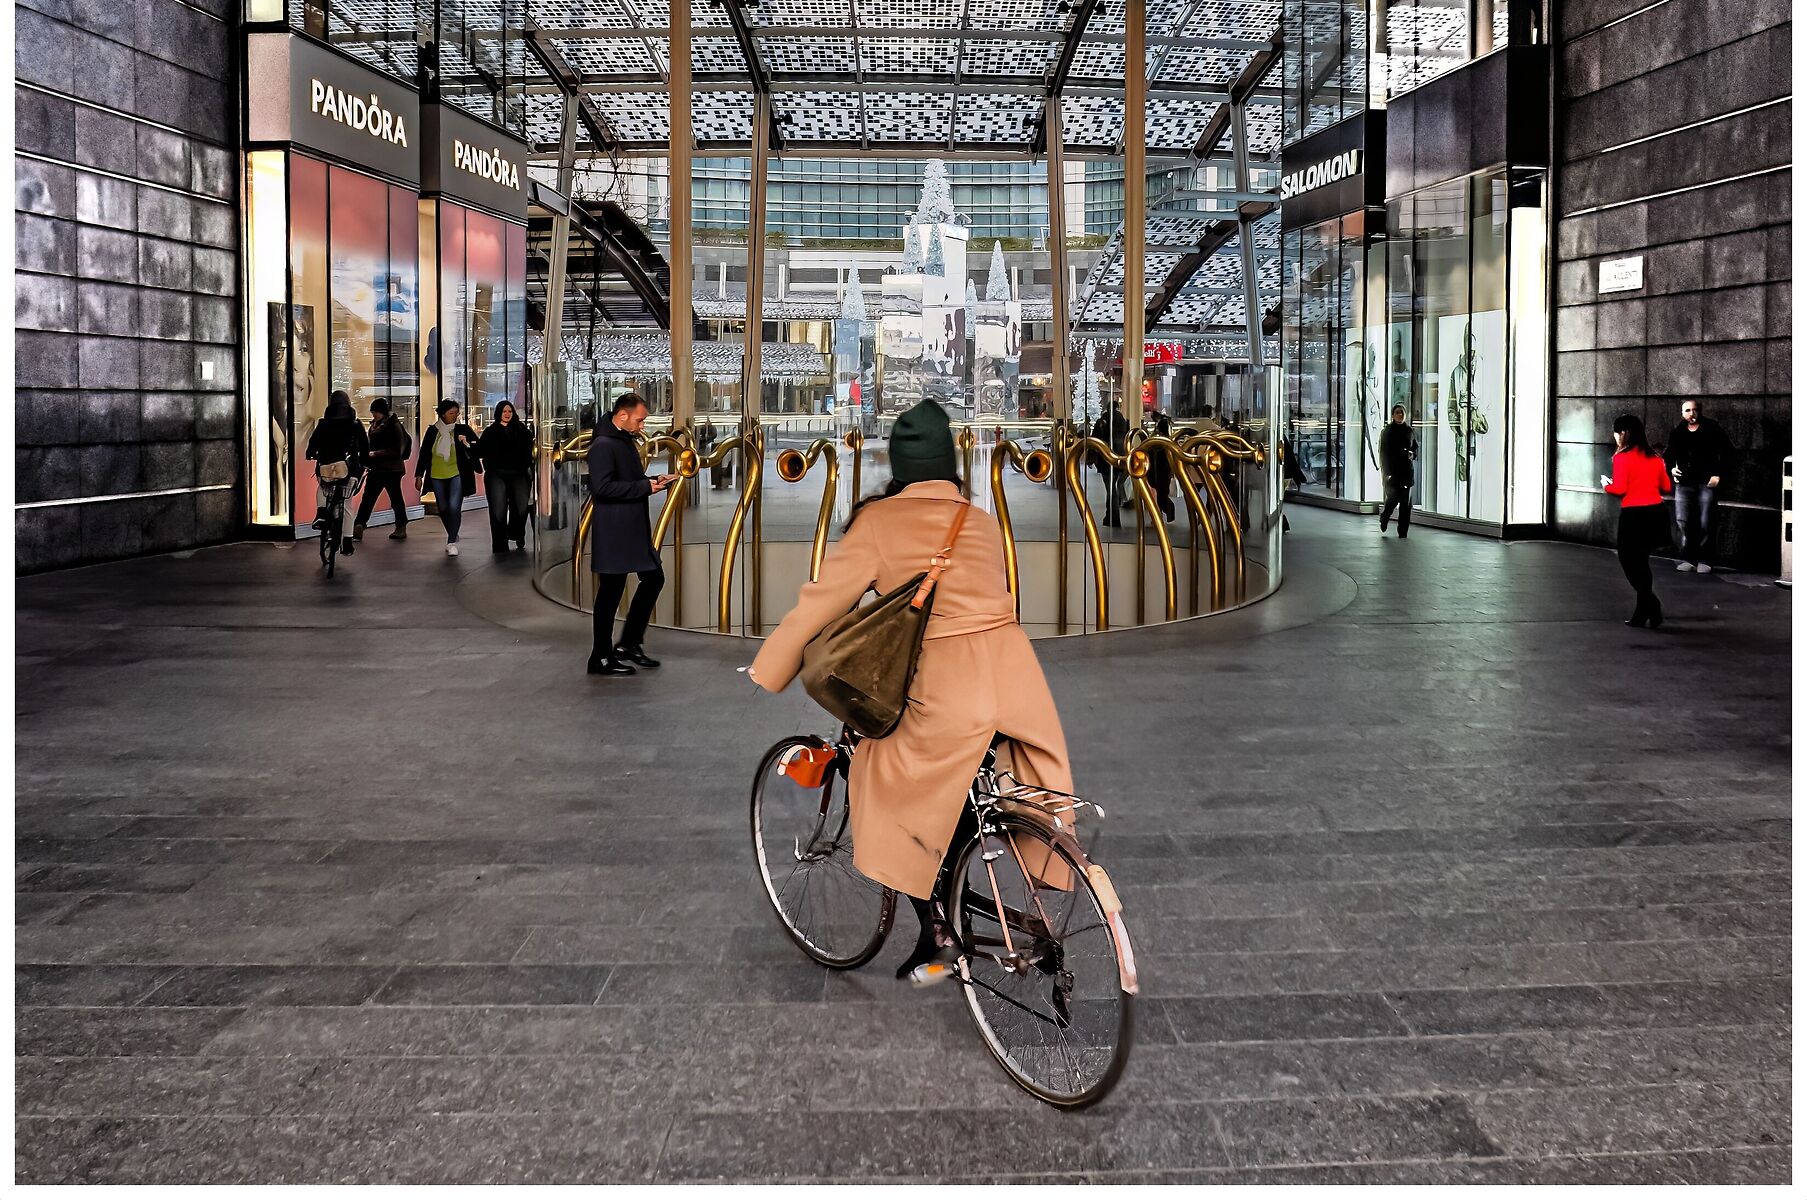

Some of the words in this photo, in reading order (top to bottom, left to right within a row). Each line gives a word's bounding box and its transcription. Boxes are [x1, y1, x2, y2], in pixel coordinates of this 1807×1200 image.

[311, 79, 408, 148] PANDORA
[455, 140, 520, 191] PANDORA
[1281, 149, 1358, 201] SALOMON
